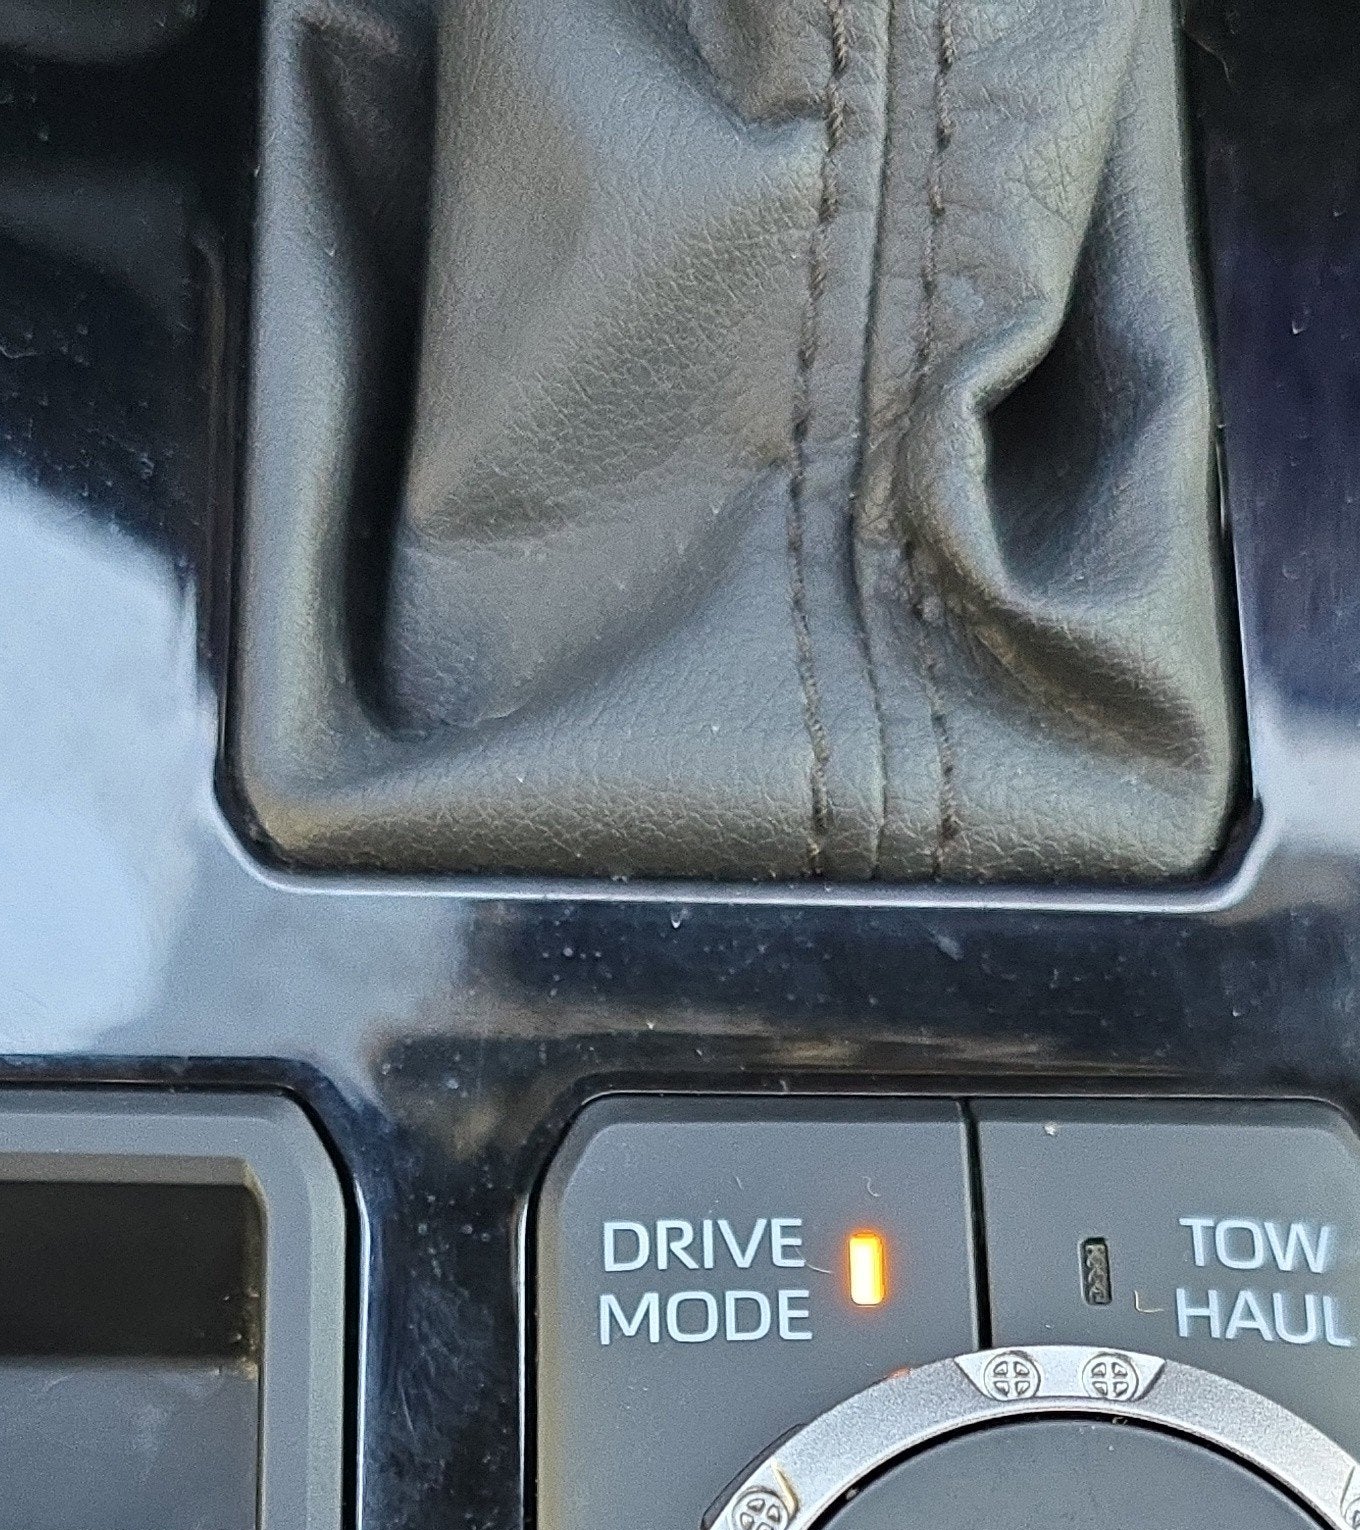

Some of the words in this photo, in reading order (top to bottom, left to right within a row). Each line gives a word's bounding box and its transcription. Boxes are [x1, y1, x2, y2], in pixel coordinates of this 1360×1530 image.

[603, 1218, 806, 1272] DRIVE
[1178, 1217, 1336, 1273] TOW
[599, 1289, 813, 1343] MODE
[1175, 1288, 1356, 1346] HAUL
